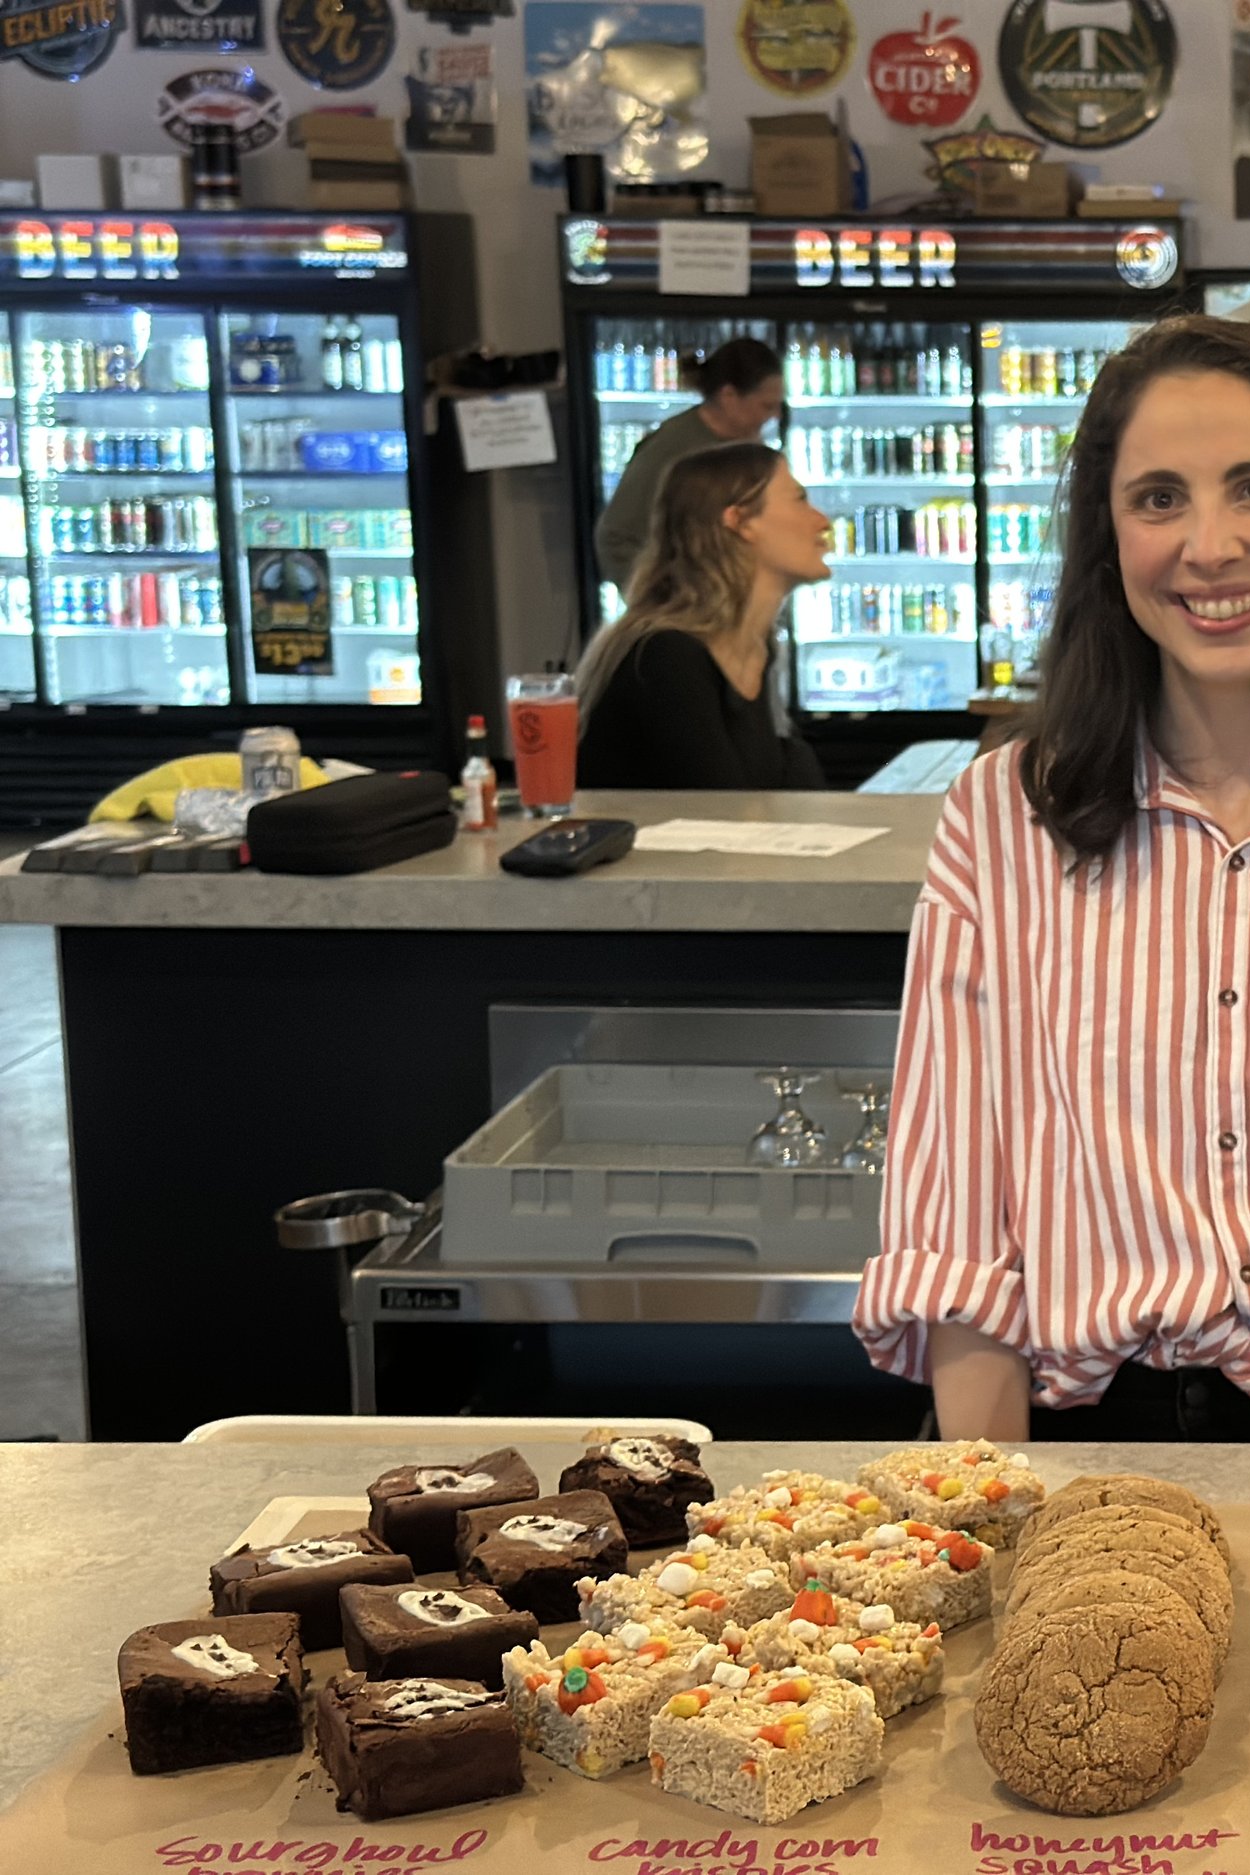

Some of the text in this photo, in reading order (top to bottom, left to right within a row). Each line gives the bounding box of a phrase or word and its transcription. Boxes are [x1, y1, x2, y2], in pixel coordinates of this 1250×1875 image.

[143, 15, 257, 41] ANCESTRY
[875, 64, 973, 96] CIDER
[17, 220, 180, 280] BEER
[795, 229, 956, 288] BEER
[588, 1830, 880, 1868] candy corn
[970, 1822, 1241, 1866] honeynut
